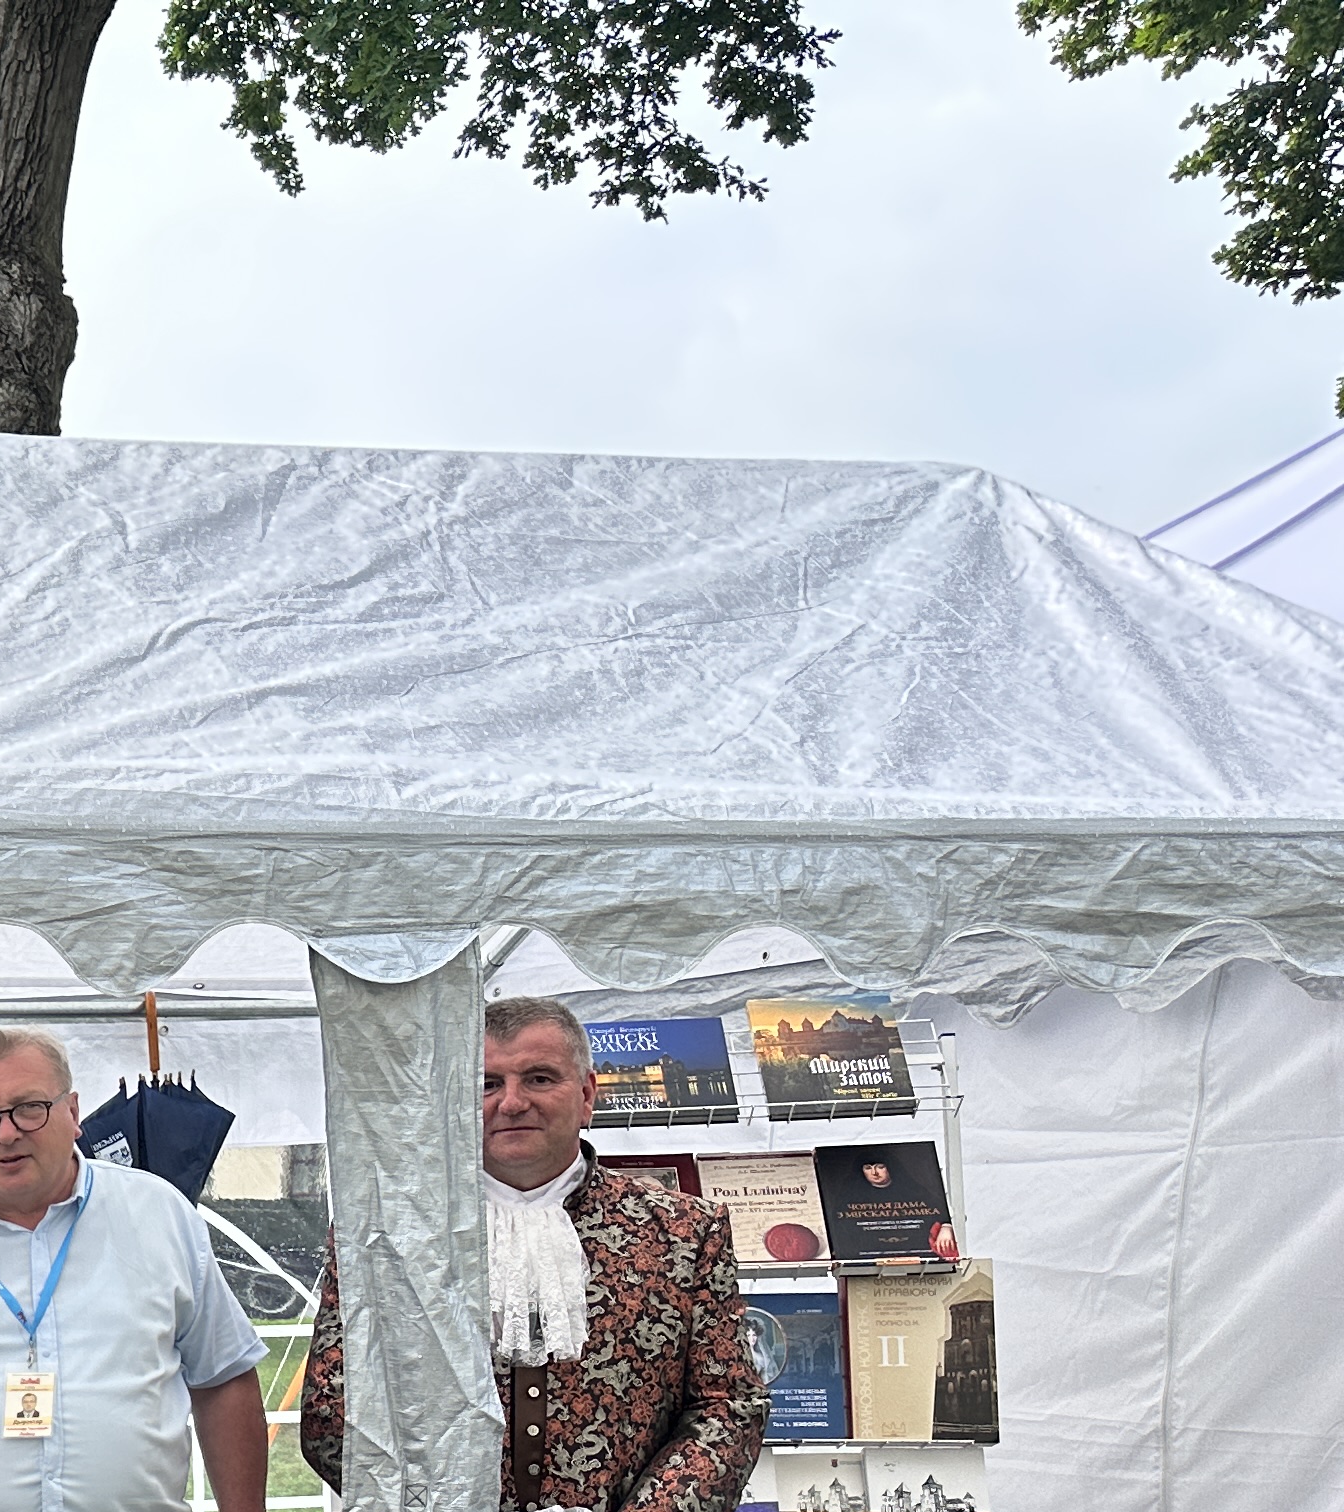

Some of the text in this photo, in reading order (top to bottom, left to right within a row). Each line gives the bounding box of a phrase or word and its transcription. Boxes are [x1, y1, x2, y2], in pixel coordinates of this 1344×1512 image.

[591, 1032, 659, 1044] МІРСКІ
[592, 1041, 661, 1053] ЗАМАК
[809, 1054, 891, 1075] Мирский
[838, 1071, 894, 1086] замок
[713, 1187, 740, 1198] Род
[847, 1200, 928, 1211] ЧОРНАЯ ДАМА
[902, 1207, 941, 1216] ЗАМКА
[873, 1287, 937, 1298] И ГРАВЮРЫ
[877, 1335, 910, 1367] II
